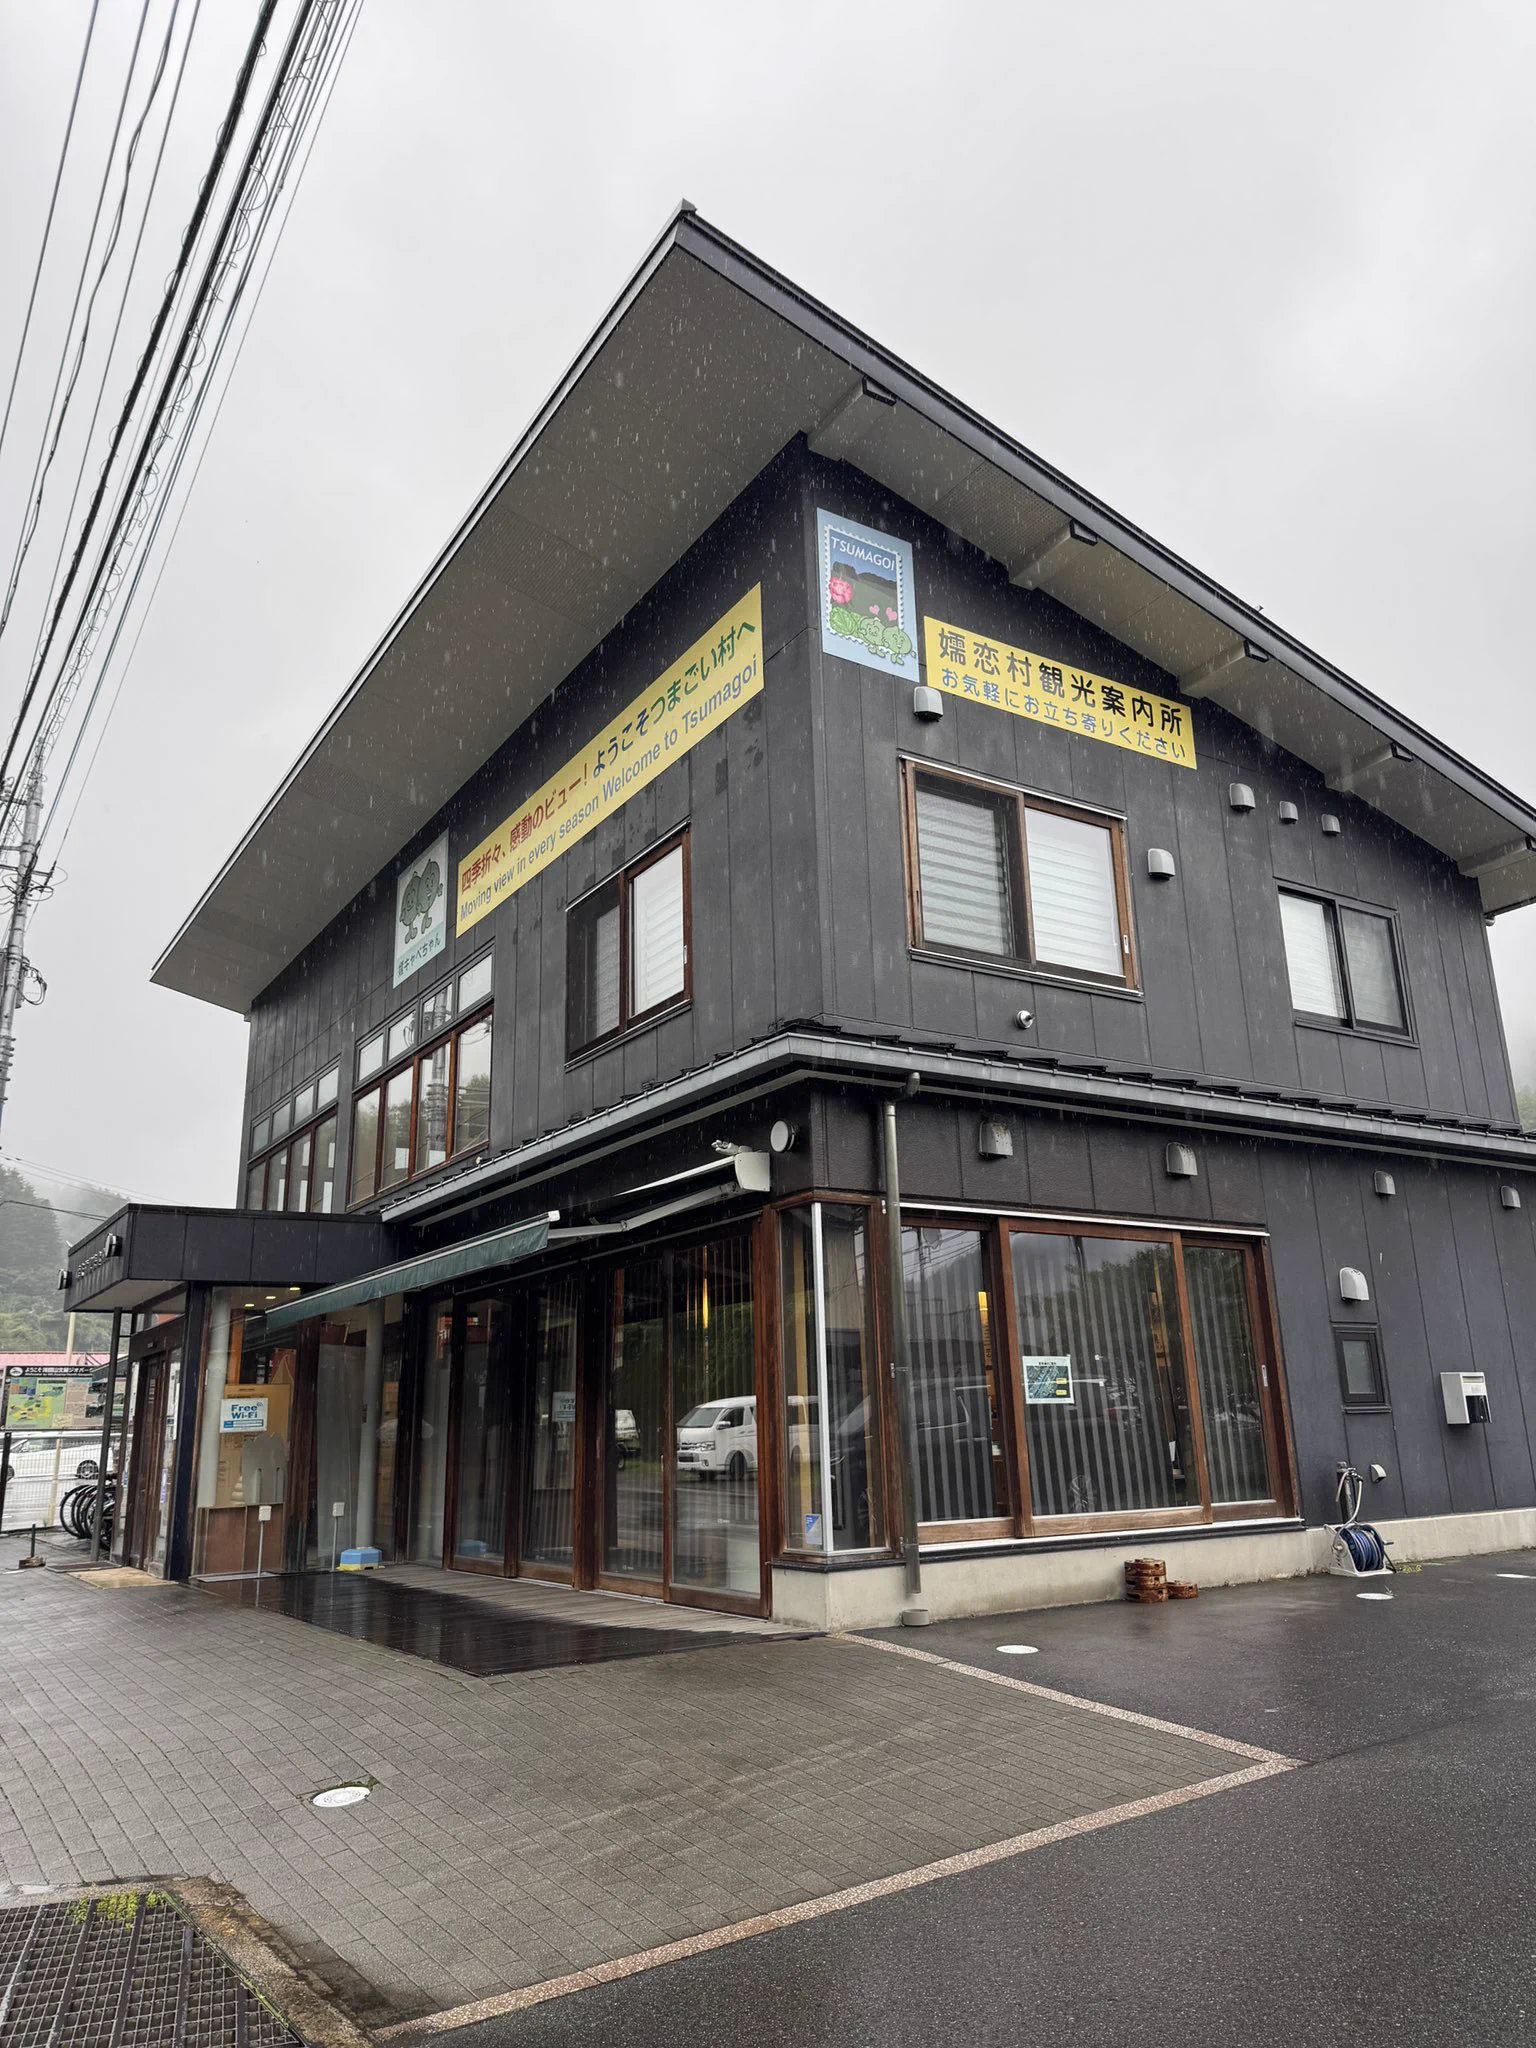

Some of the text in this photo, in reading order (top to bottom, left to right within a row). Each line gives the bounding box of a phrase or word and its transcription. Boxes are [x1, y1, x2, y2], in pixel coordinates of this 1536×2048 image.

[830, 536, 896, 571] TSUMAGOI
[938, 627, 1183, 737] 嬬恋村観光案内所
[942, 667, 1186, 759] お気軽にお立ち寄りください
[460, 653, 757, 921] Moving view in every season Welcome to Tsumagoi
[231, 1404, 258, 1412] Free
